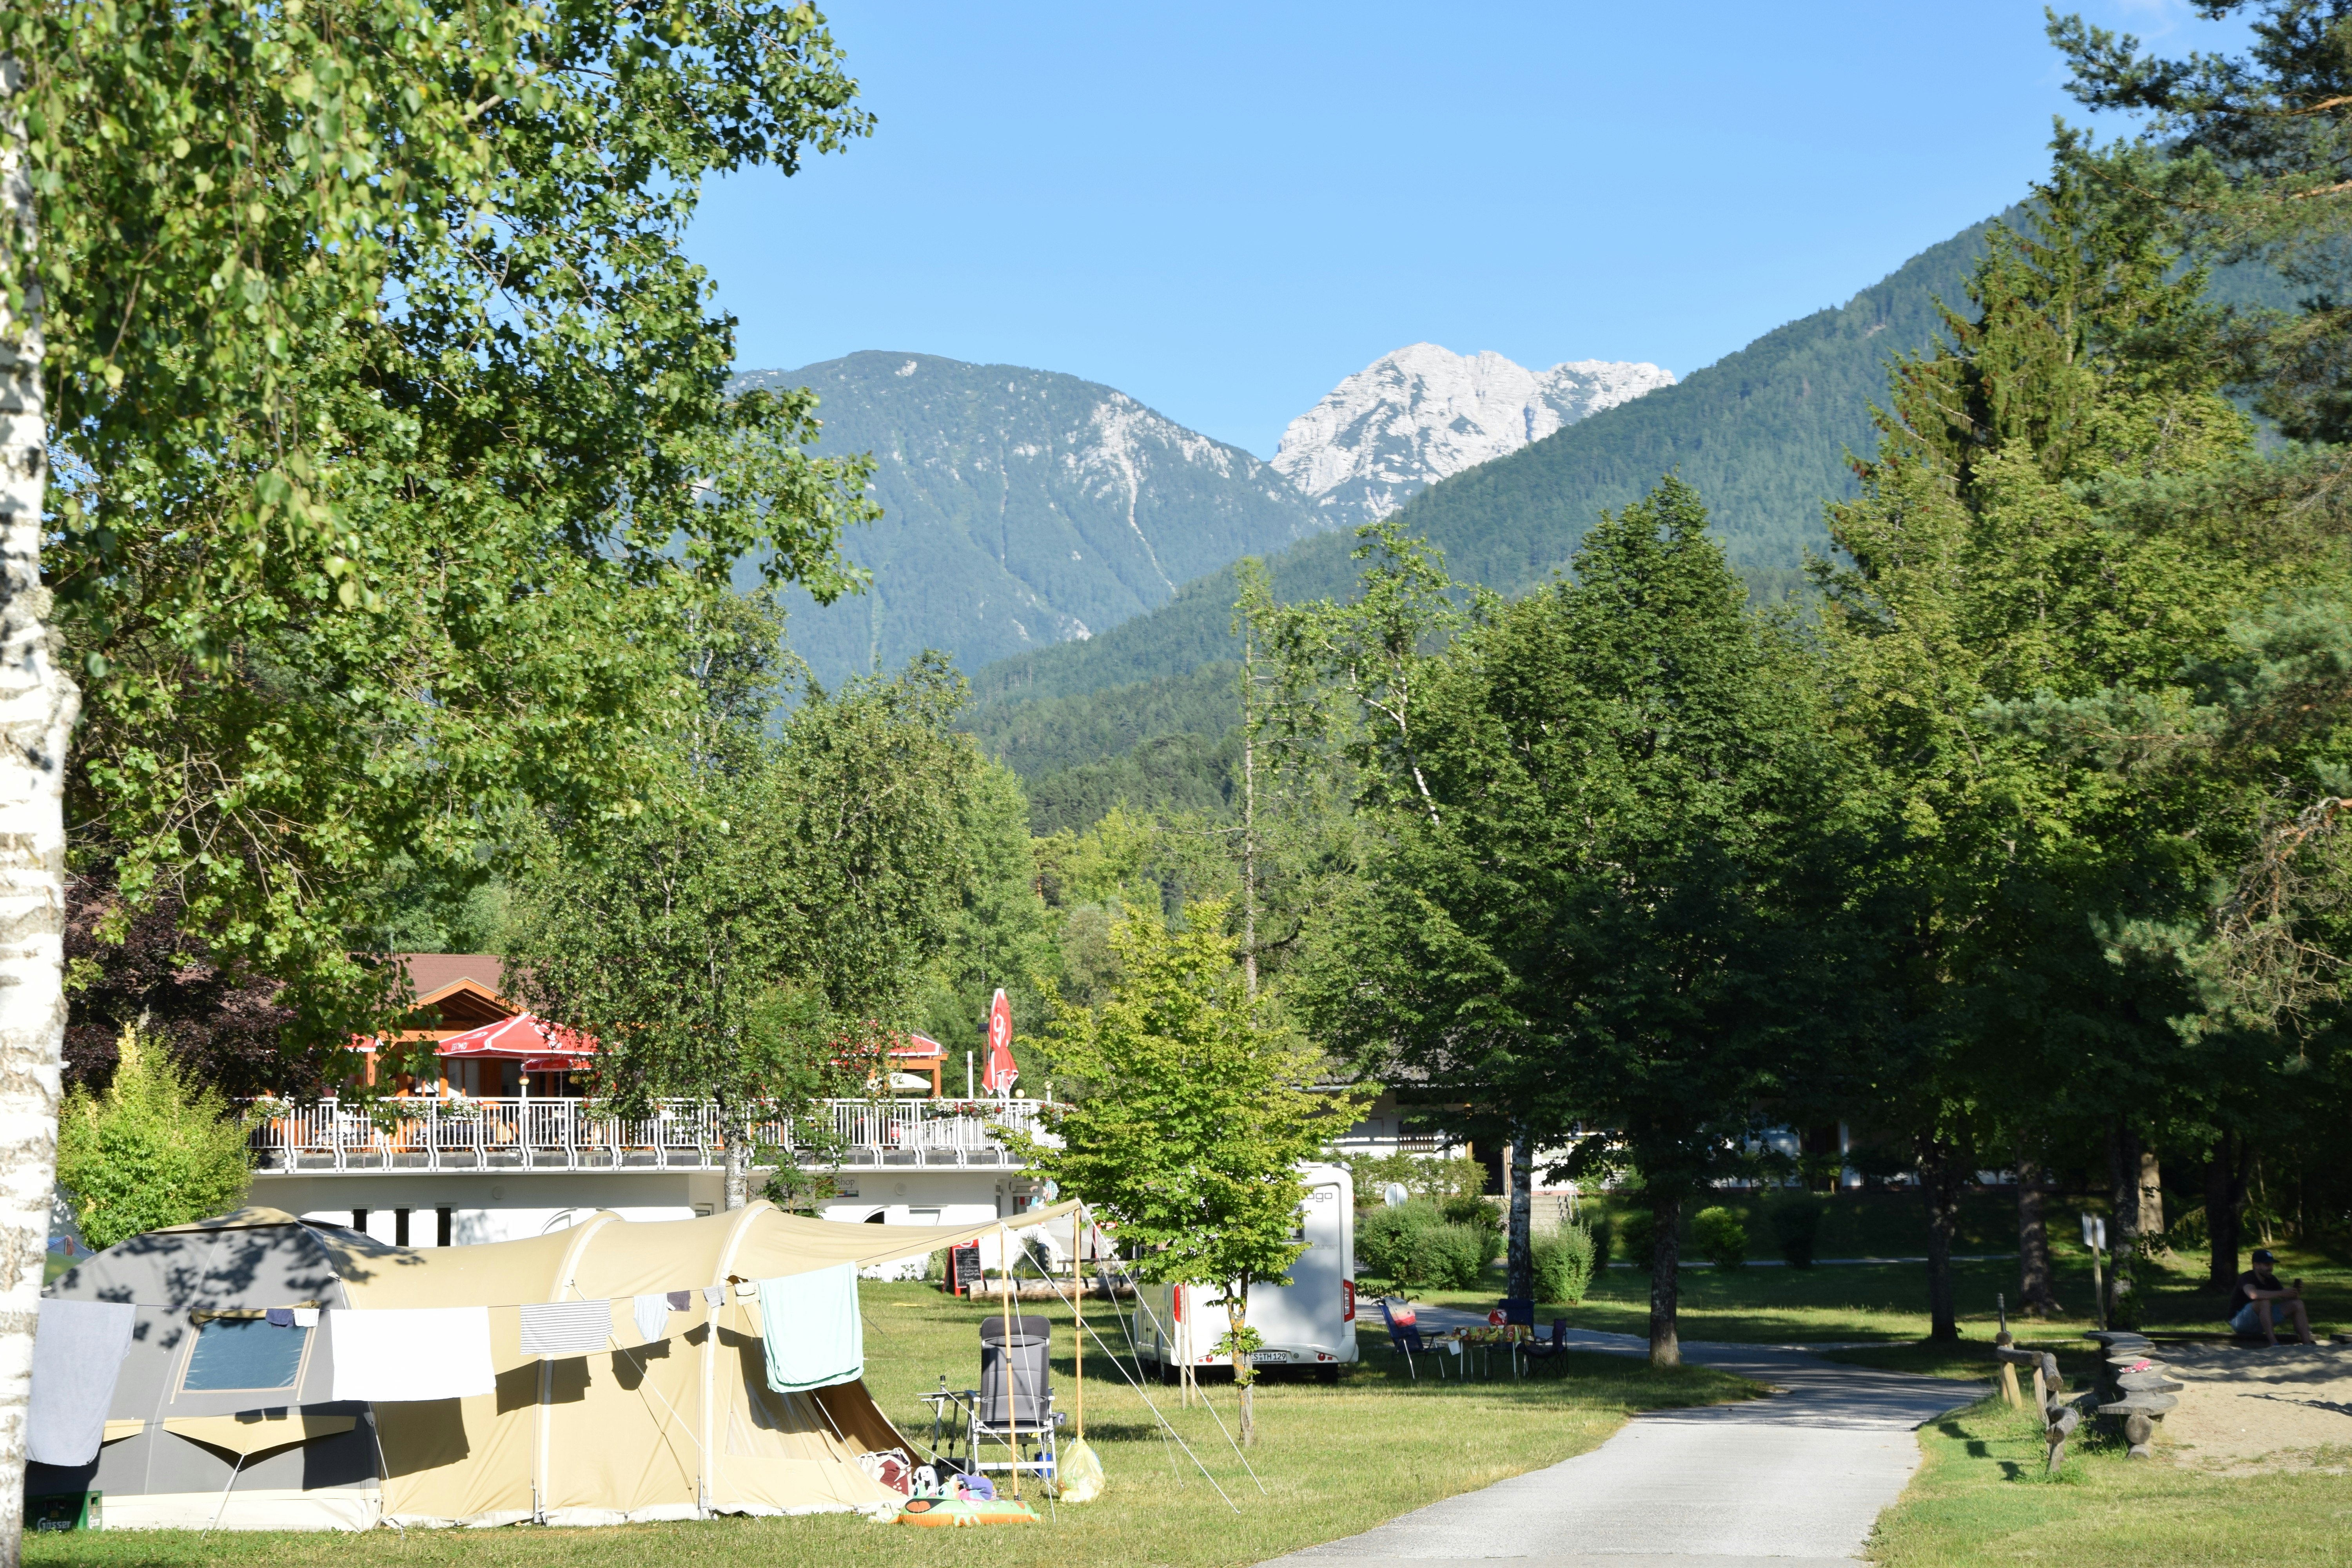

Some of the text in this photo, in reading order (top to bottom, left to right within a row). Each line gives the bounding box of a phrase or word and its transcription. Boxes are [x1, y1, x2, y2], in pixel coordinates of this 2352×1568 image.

[836, 1177, 855, 1189] Shop
[1307, 1192, 1332, 1203] ago
[37, 1517, 71, 1532] Gösser
